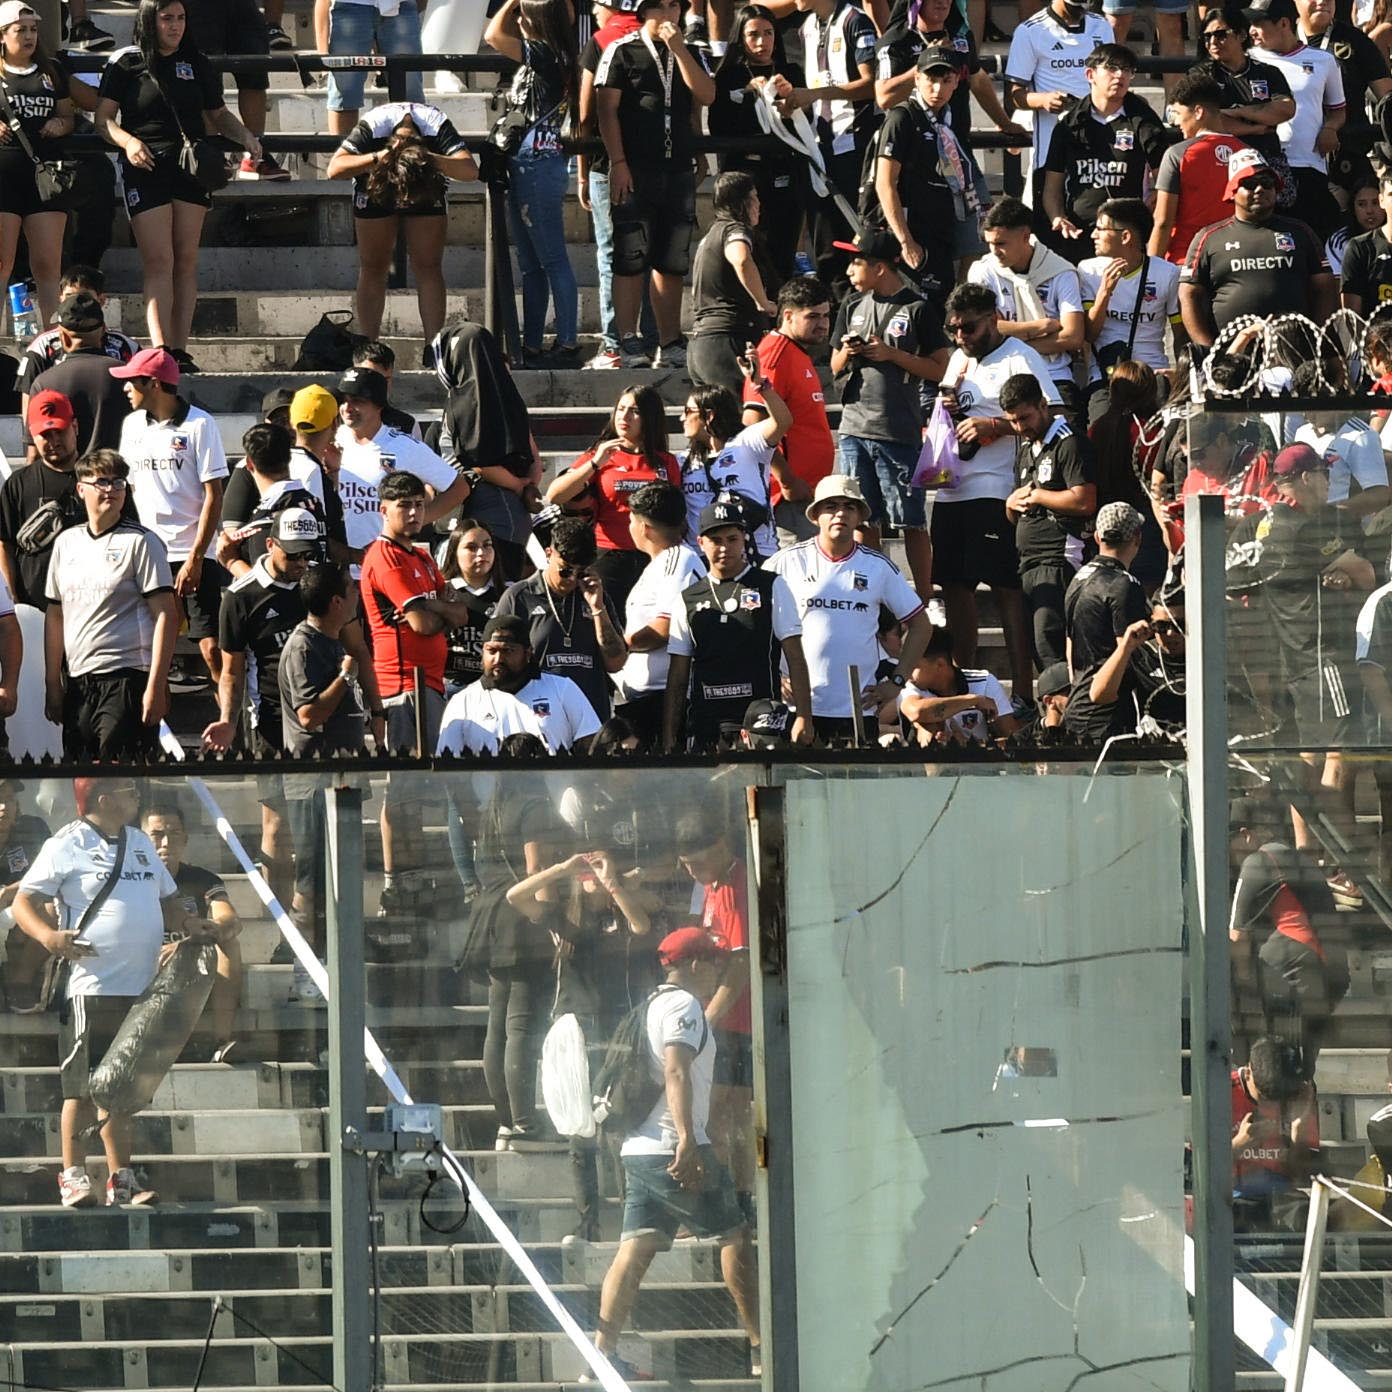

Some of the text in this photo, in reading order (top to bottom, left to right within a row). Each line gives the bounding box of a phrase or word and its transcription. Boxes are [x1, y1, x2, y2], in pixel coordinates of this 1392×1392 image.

[23, 106, 52, 121] Sur
[1076, 158, 1127, 177] Pilsen
[1091, 174, 1124, 189] Sur
[1230, 255, 1295, 272] DIRECTV
